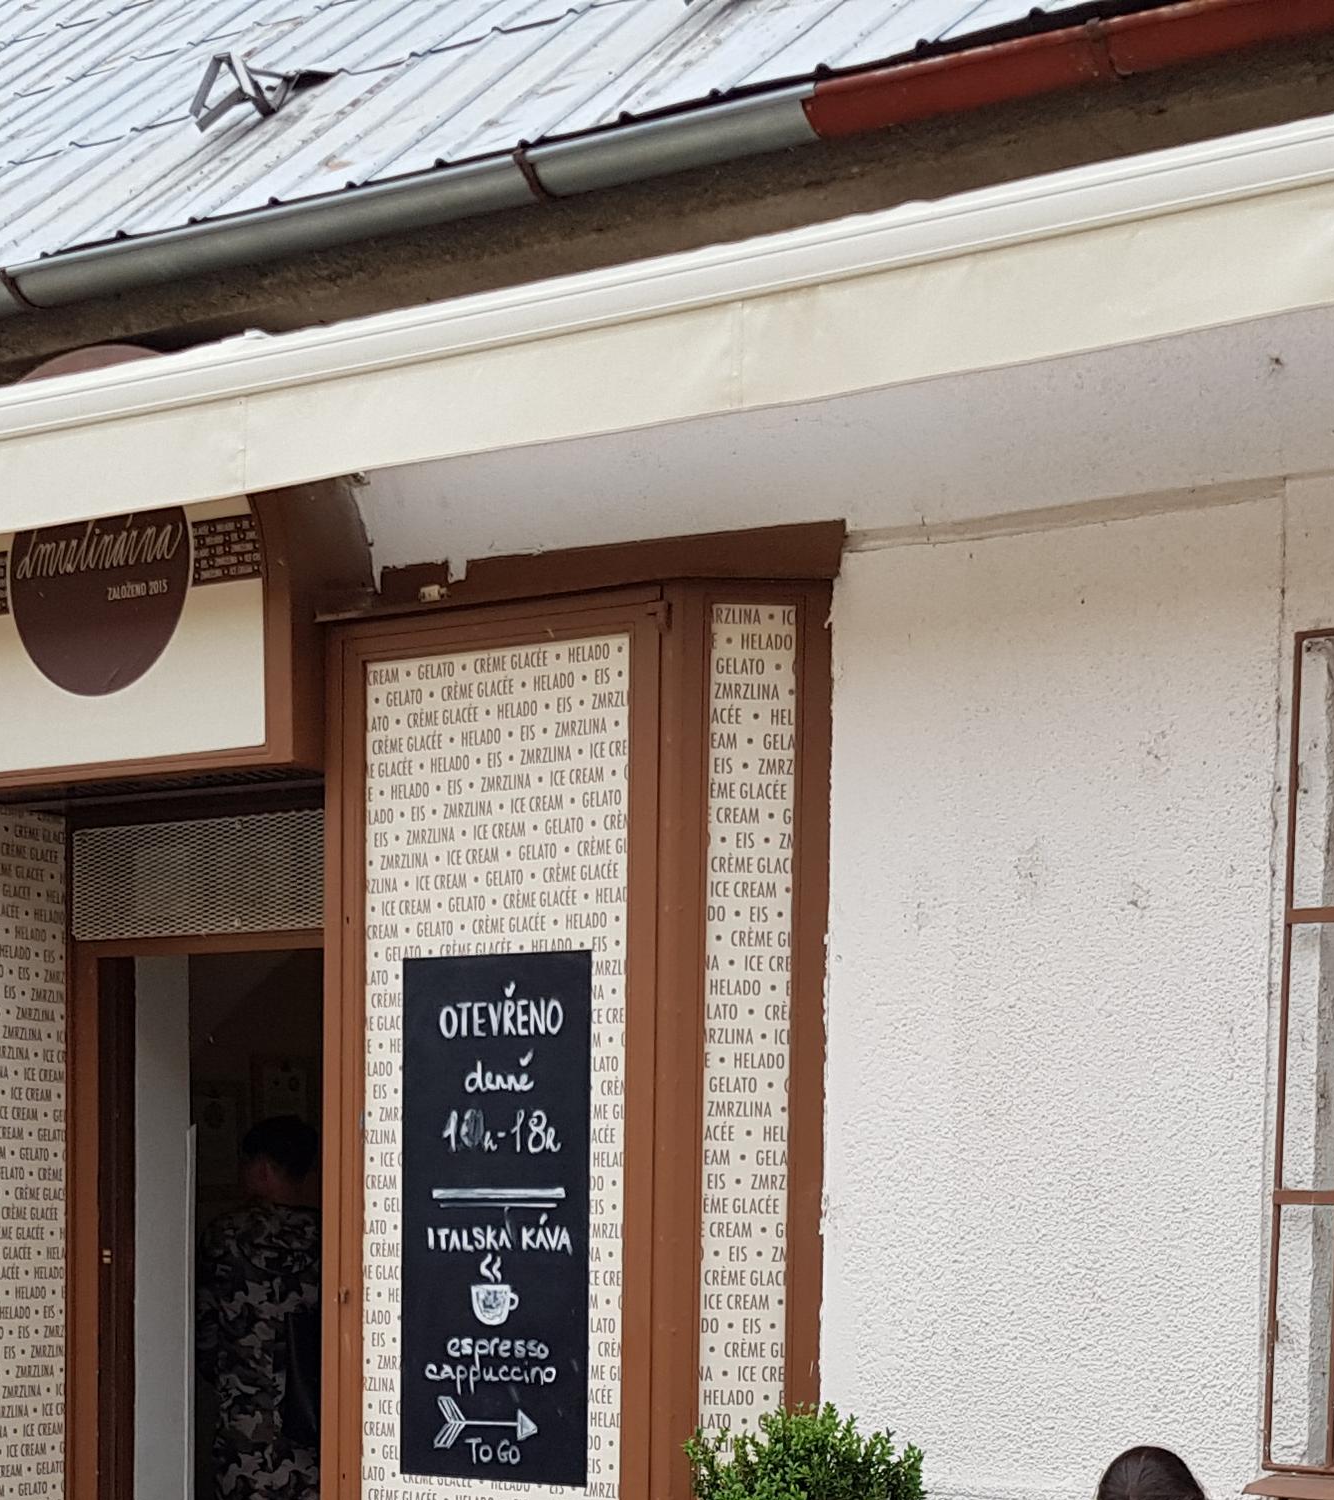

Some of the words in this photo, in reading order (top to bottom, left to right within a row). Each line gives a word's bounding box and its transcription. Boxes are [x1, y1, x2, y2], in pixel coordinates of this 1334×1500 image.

[148, 579, 168, 596] 2015
[741, 633, 792, 651] HELADO
[418, 660, 454, 680] GELATO
[568, 641, 610, 664] HELADO
[716, 657, 764, 675] GELATO
[386, 688, 422, 707] GELATO
[534, 671, 574, 691] HELADO
[595, 667, 610, 685] EIS
[714, 681, 779, 700] ZMRZLINA
[461, 728, 501, 747] HELADO
[520, 724, 535, 742] EIS
[555, 717, 607, 738] ZMRZLINA
[431, 754, 469, 773] HELADO
[487, 751, 502, 768] EIS
[520, 745, 571, 765] ZMRZLINA
[590, 741, 605, 759] ICE
[714, 757, 733, 774] EIS
[411, 805, 425, 822] EIS
[443, 800, 492, 820] ZMRZLINA
[511, 797, 526, 814] ICE
[529, 794, 563, 812] CREAM
[582, 789, 622, 808] GELATO
[716, 807, 759, 824] CREAM
[374, 832, 388, 848] EIS
[406, 826, 455, 846] ZMRZLINA
[474, 824, 488, 840] ICE
[492, 821, 525, 839] CREAM
[545, 816, 584, 835] GELATO
[736, 832, 755, 848] EIS
[416, 875, 430, 891] ICE
[434, 872, 467, 890] CREAM
[486, 869, 523, 887] GELATO
[711, 881, 730, 897] ICE
[733, 881, 776, 898] CREAM
[750, 906, 768, 923] EIS
[417, 920, 453, 938] GELATO
[566, 912, 607, 930] HELADO
[710, 979, 761, 996] HELADO
[439, 981, 564, 1039] OTEVŘENO
[734, 1052, 785, 1069] HELADO
[464, 1048, 534, 1093] denně
[709, 1076, 757, 1093] GELATO
[707, 1101, 772, 1118] ZMRZLINA
[522, 1213, 573, 1255] KÁVA
[729, 1246, 747, 1262] EIS
[704, 1293, 722, 1310] ICE
[727, 1294, 769, 1310] CREAM
[0, 1306, 30, 1320] HELADO
[447, 1337, 550, 1367] espresso
[15, 1364, 54, 1379] ZMRZLINA
[425, 1363, 557, 1395] cappuccino
[704, 1389, 754, 1406] HELADO
[18, 1481, 47, 1496] GELATO
